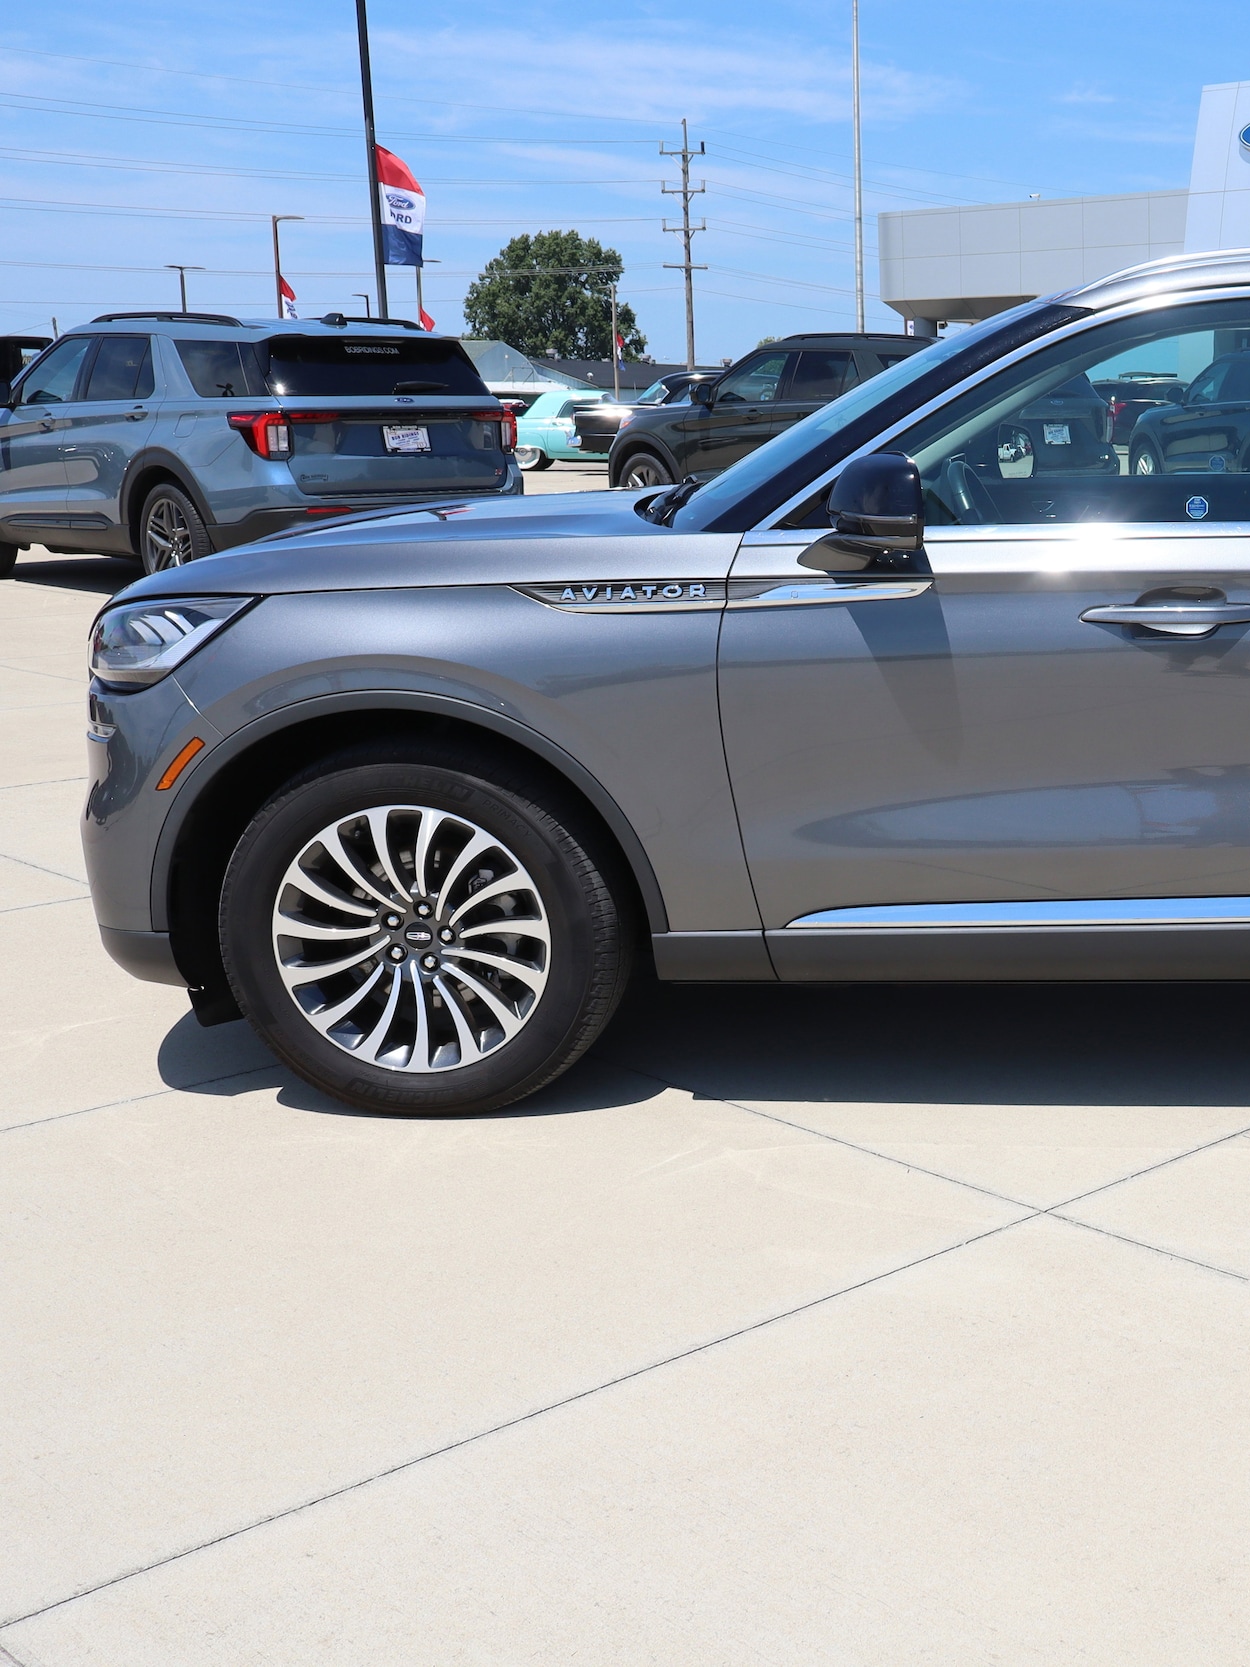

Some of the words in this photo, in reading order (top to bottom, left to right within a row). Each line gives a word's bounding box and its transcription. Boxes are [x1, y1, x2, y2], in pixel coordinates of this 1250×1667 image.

[389, 195, 410, 208] Ford
[344, 346, 400, 354] BOBRIDINGS.COM
[560, 584, 706, 600] AVIATOR
[482, 798, 532, 837] PRIMACY
